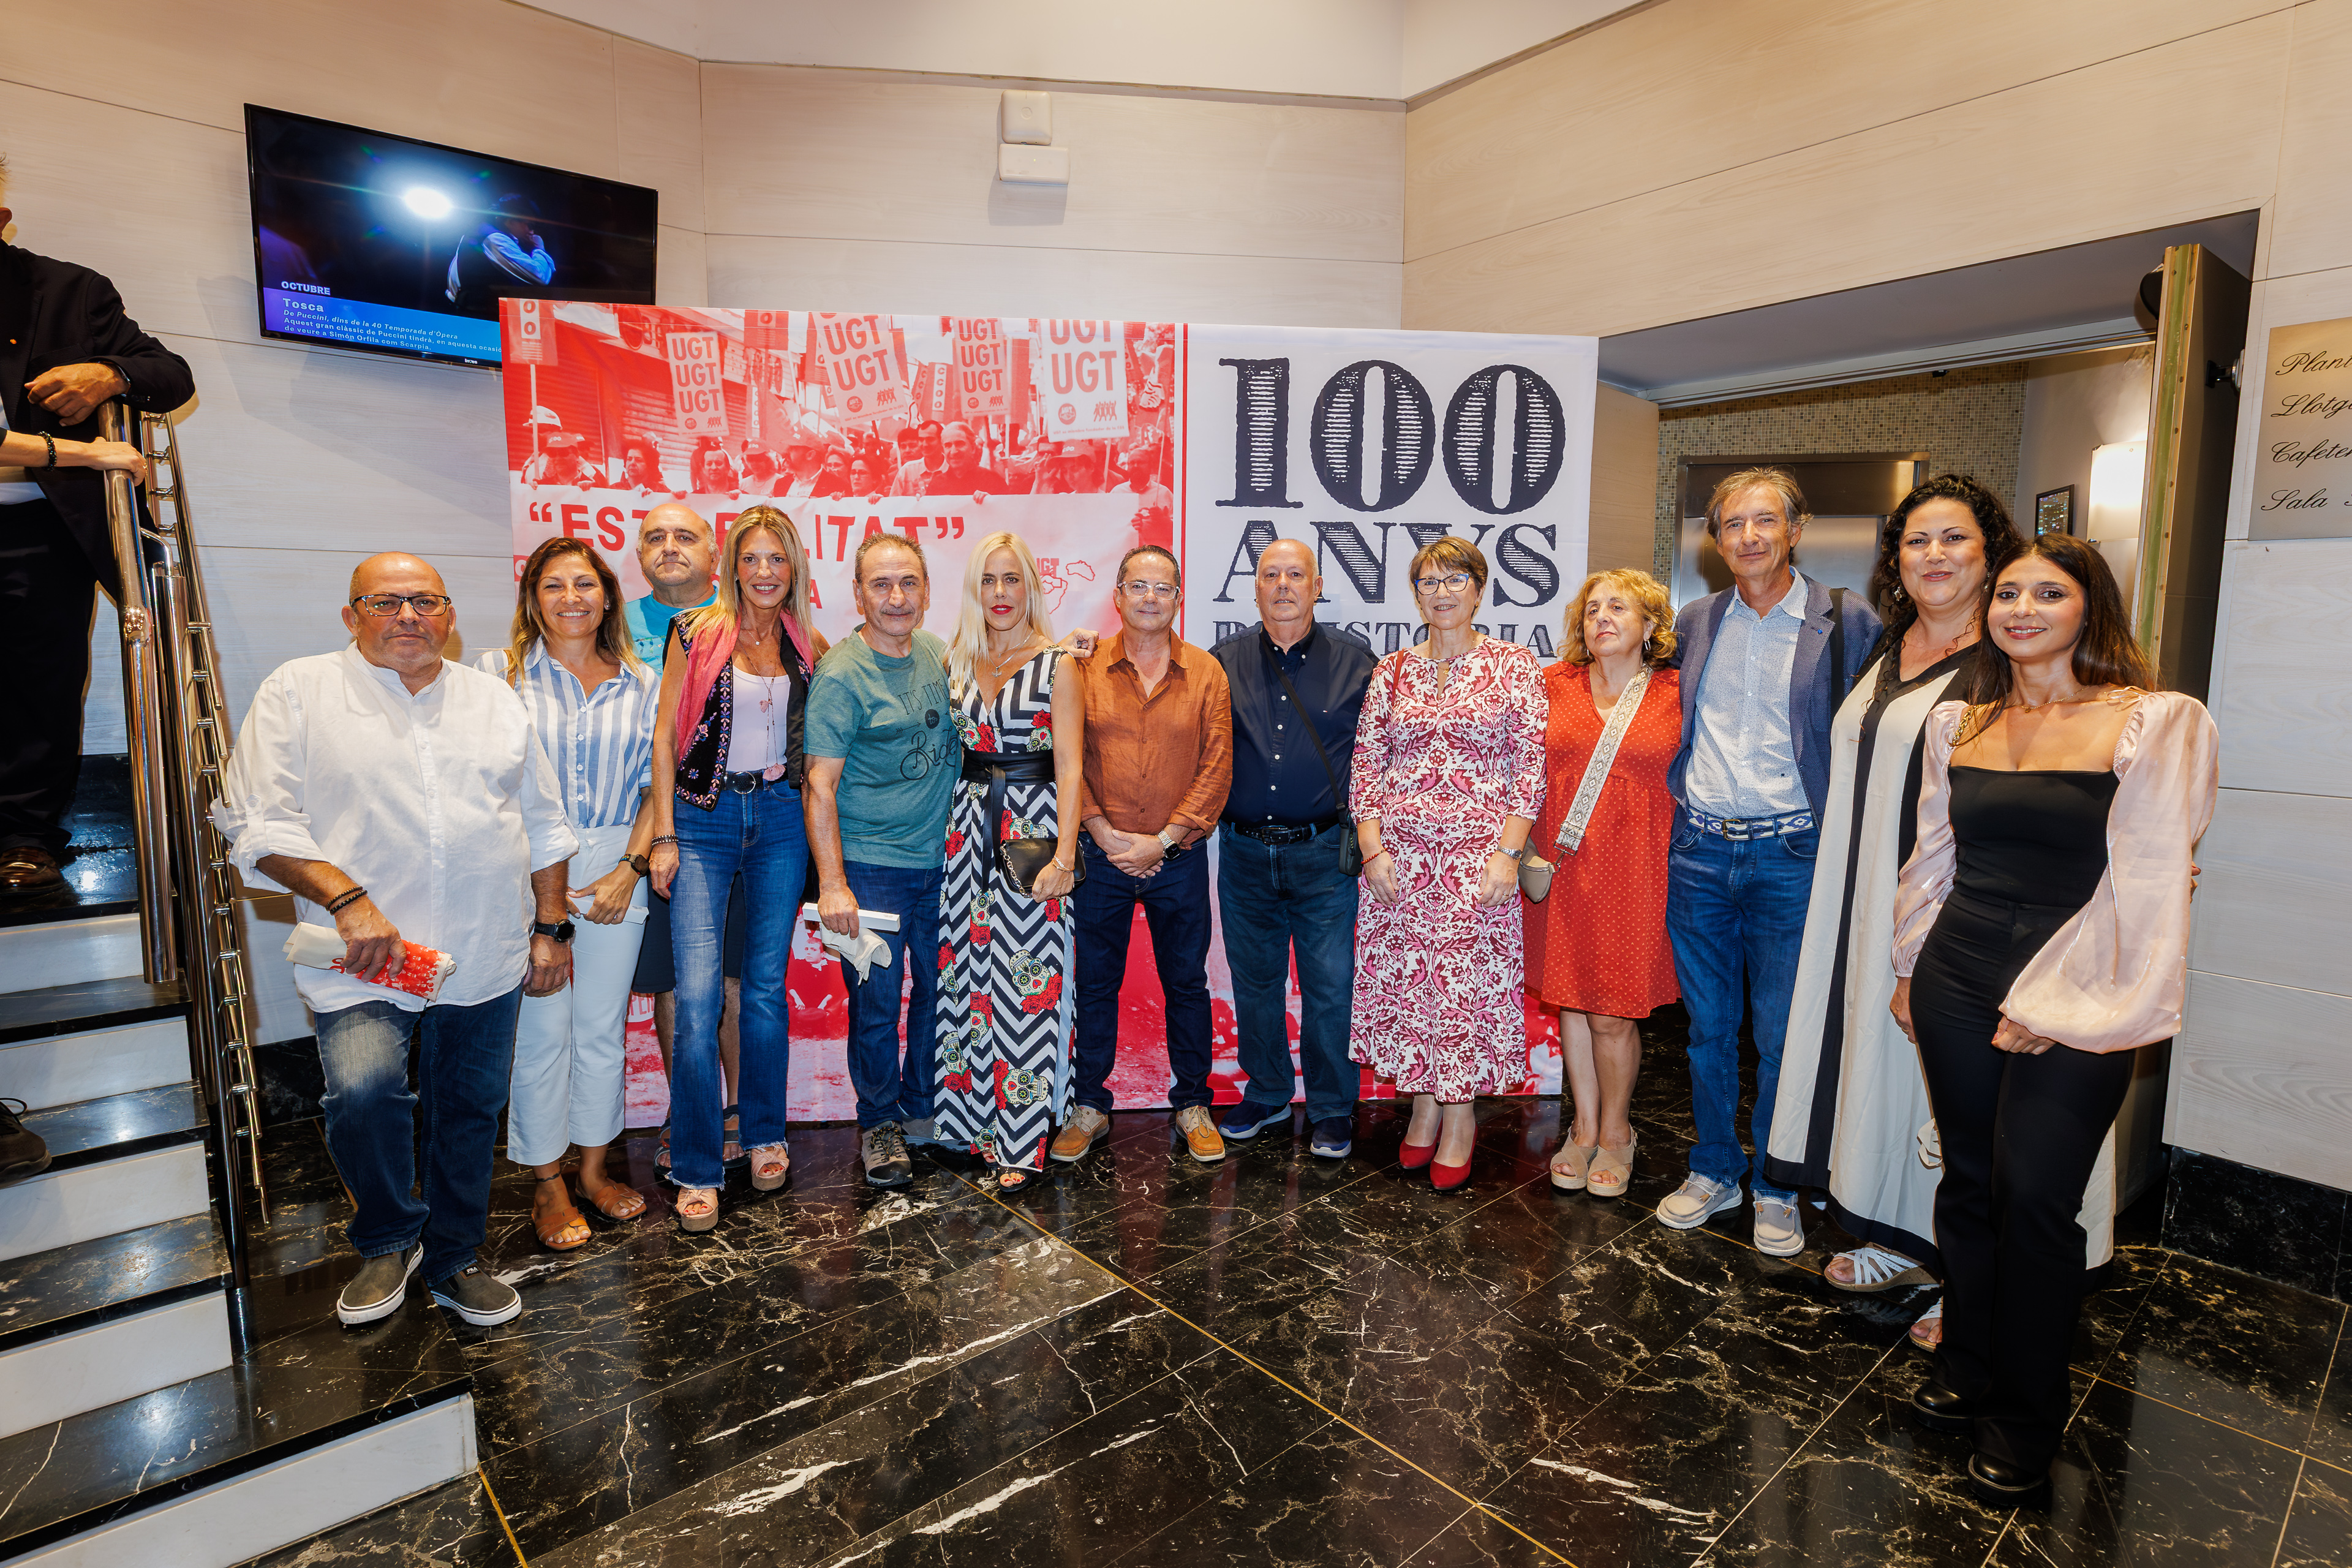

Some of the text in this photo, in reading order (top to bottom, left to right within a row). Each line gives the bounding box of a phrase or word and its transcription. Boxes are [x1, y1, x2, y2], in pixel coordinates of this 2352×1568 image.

[281, 281, 331, 295] OCTUBRE
[282, 298, 324, 312] Tosca
[284, 317, 314, 327] Aquest
[336, 325, 364, 334] clàssic
[378, 330, 407, 339] Puccini
[409, 334, 434, 344] tindrà,
[296, 311, 329, 322] Puccini,
[331, 315, 349, 324] dins
[384, 323, 426, 335] Temporada
[429, 330, 458, 339] d'Òpera
[824, 315, 880, 355] UGT
[959, 318, 998, 342] UGT
[329, 331, 355, 340] Simón
[356, 335, 379, 344] Orfila
[400, 341, 431, 350] Scarpia.
[672, 337, 714, 361] UGT
[960, 342, 1001, 368] UGT
[675, 362, 717, 387] UGT
[833, 349, 890, 391] UGT
[963, 369, 1003, 393] UGT
[1051, 350, 1117, 394] UGT
[679, 388, 720, 413] UGT
[2270, 393, 2352, 419] Llotg
[1215, 356, 1566, 515] 100
[2260, 488, 2328, 511] Sala
[897, 679, 951, 715] IT'S TIME
[928, 714, 938, 724] to
[900, 725, 959, 778] Ride
